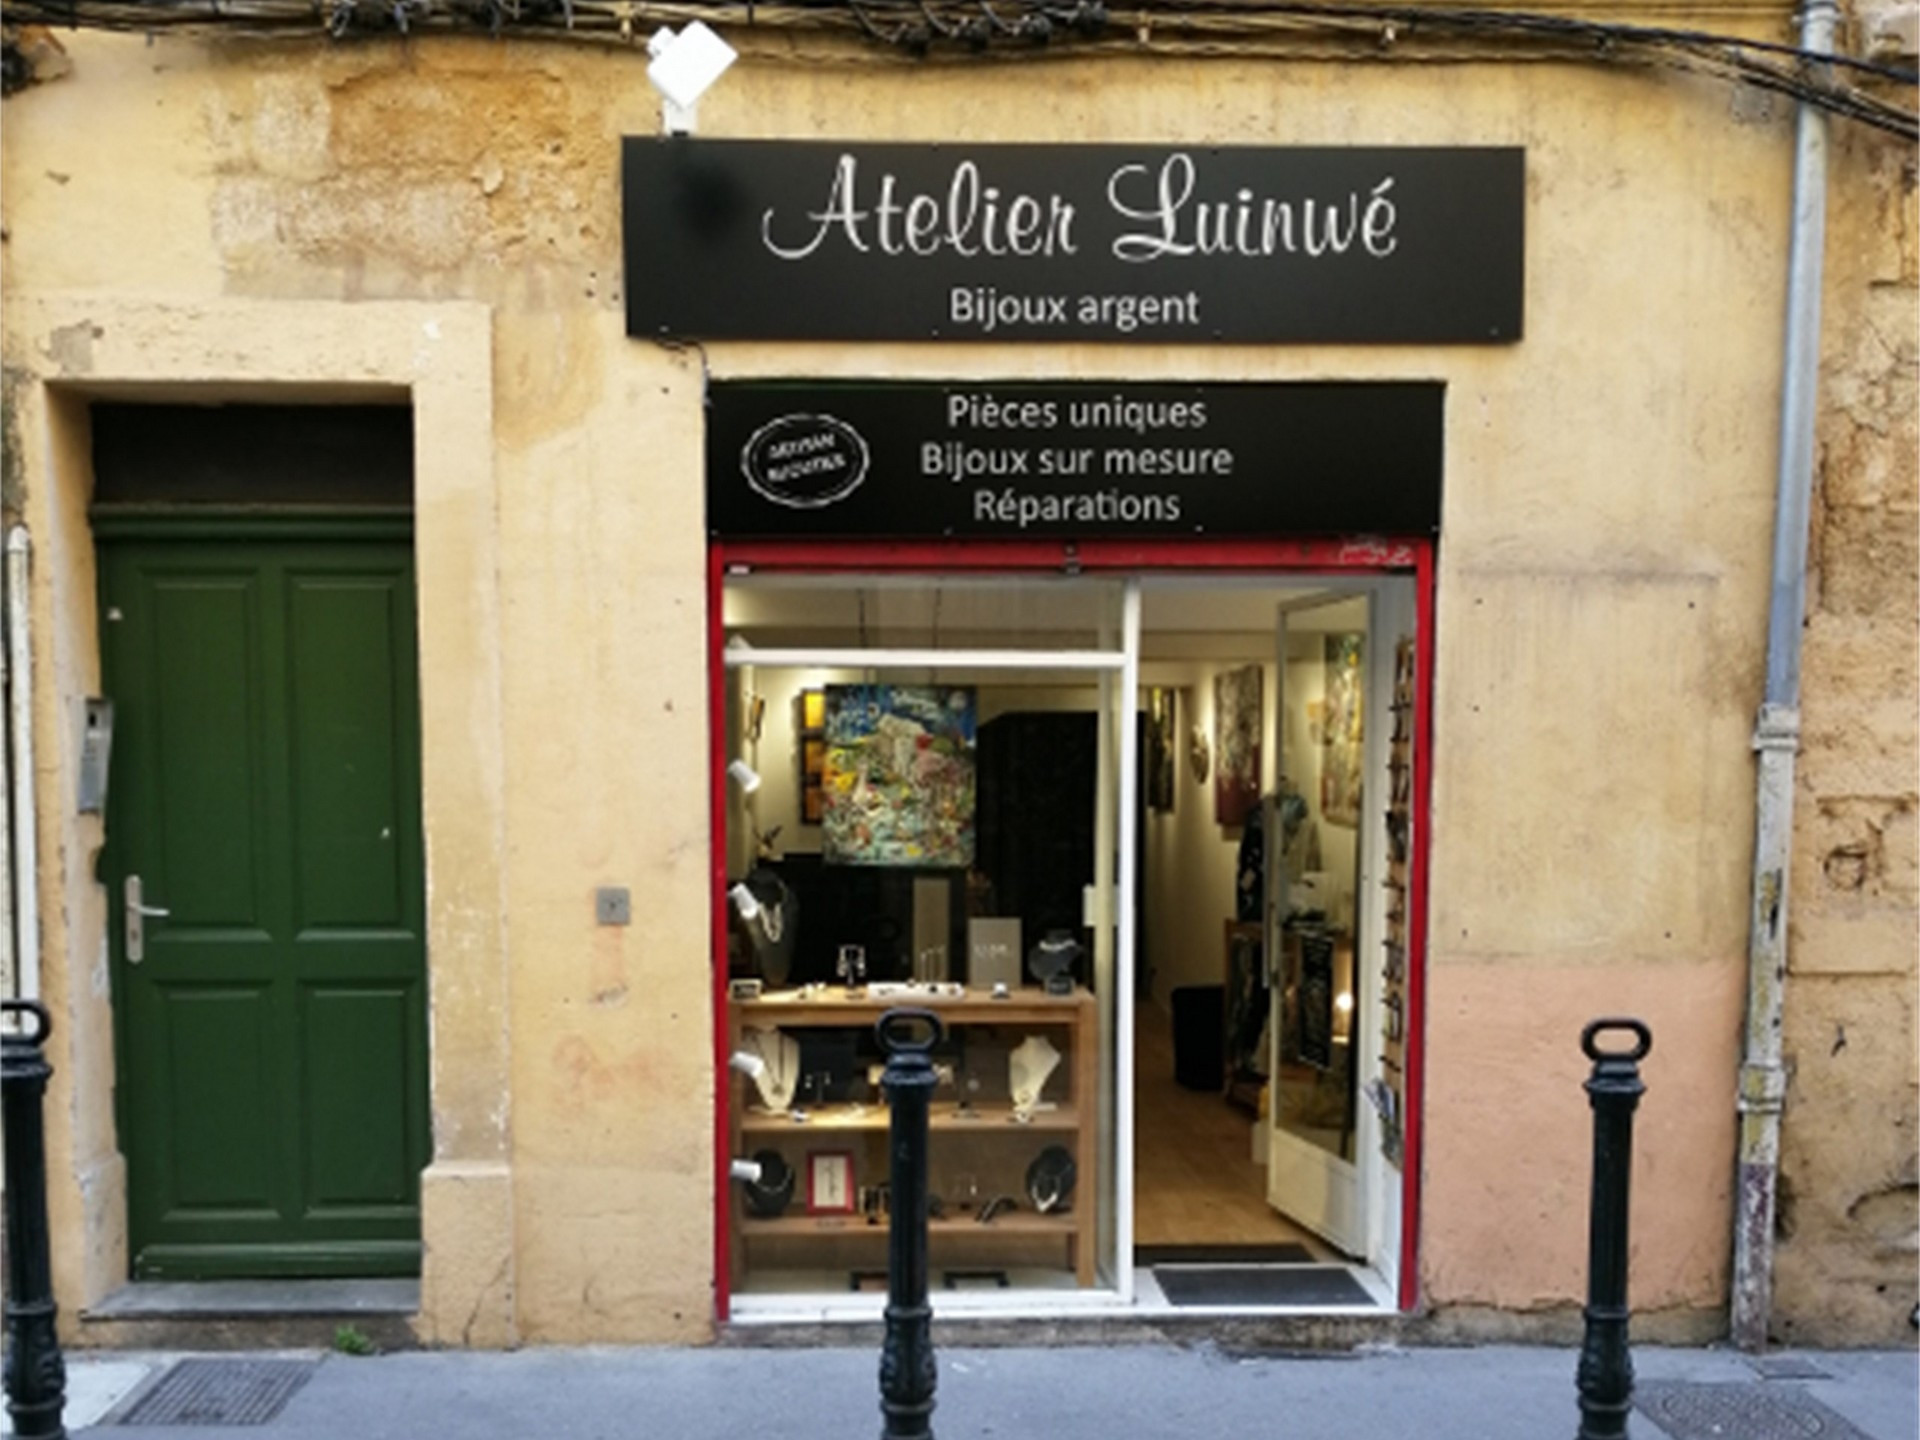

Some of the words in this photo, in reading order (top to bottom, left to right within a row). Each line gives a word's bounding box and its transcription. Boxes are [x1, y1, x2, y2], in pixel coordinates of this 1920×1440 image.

[762, 153, 1078, 260] Atelier
[1107, 152, 1398, 263] Luinwé
[951, 288, 1067, 332] Bijoux
[1078, 291, 1200, 333] argent
[949, 394, 1058, 428] Pièces
[1070, 394, 1207, 433] uniques
[922, 443, 1028, 482] Bijoux
[1040, 449, 1093, 474] sur
[1105, 449, 1233, 474] mesure
[975, 489, 1180, 527] Réparations
